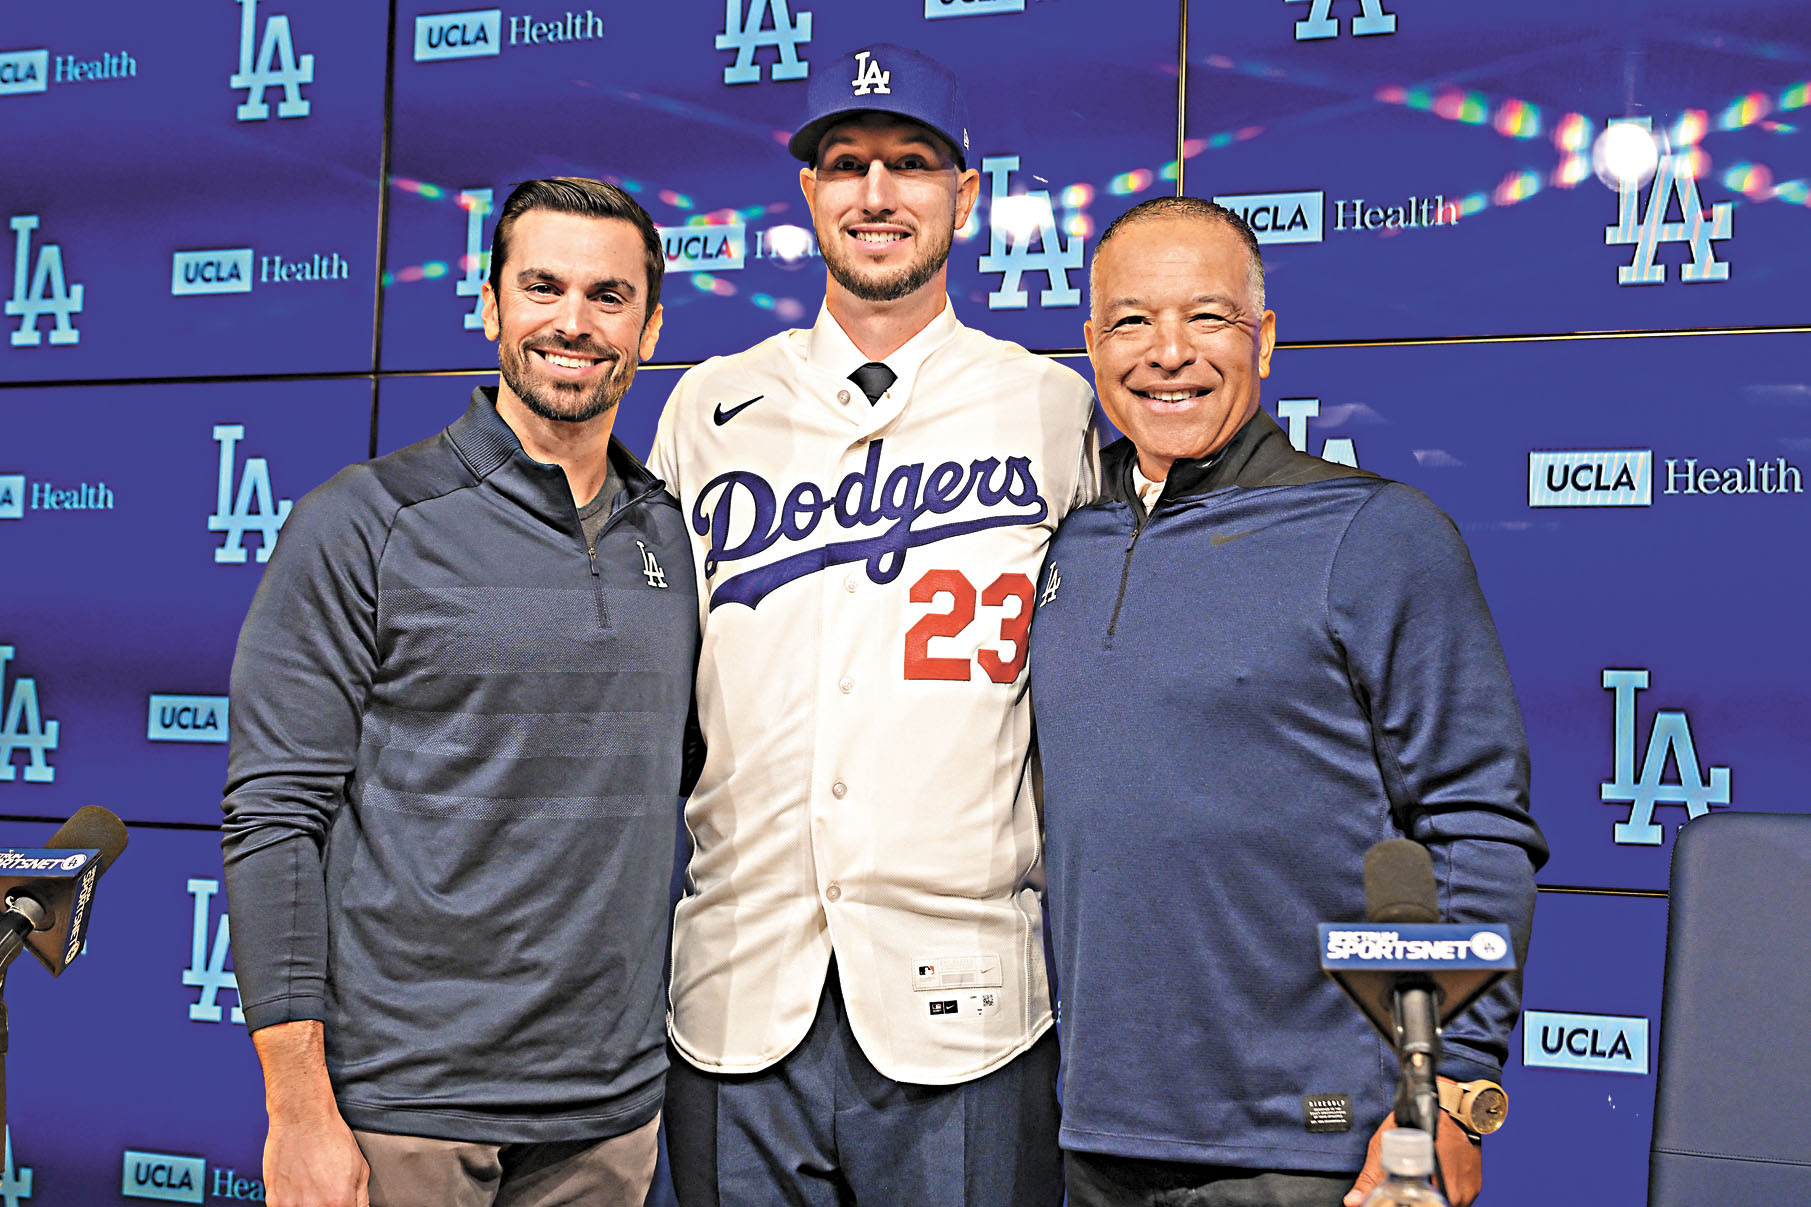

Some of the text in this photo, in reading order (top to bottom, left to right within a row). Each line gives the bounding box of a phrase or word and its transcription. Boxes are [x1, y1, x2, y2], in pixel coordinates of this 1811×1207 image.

[427, 10, 605, 49] UCLA Health
[0, 50, 137, 84] CLA Health
[230, 0, 314, 121] LA
[851, 51, 891, 96] LA
[979, 155, 1085, 310] LA
[1334, 195, 1460, 232] Health
[664, 235, 733, 262] UCLA
[4, 215, 84, 346] LA
[184, 252, 349, 286] UCLA Health
[31, 481, 115, 510] Health
[208, 424, 294, 564] LA
[1546, 457, 1804, 496] UCLA Health
[692, 439, 1048, 598] Dodgers
[636, 540, 669, 588] LA
[1039, 560, 1062, 608] LA
[904, 569, 1034, 684] 23
[160, 706, 219, 730] UCLA
[1601, 669, 1731, 845] LA
[1327, 940, 1471, 960] SPORTSNET
[1540, 1025, 1632, 1060] UCLA
[135, 1162, 266, 1200] UCLA Hea
